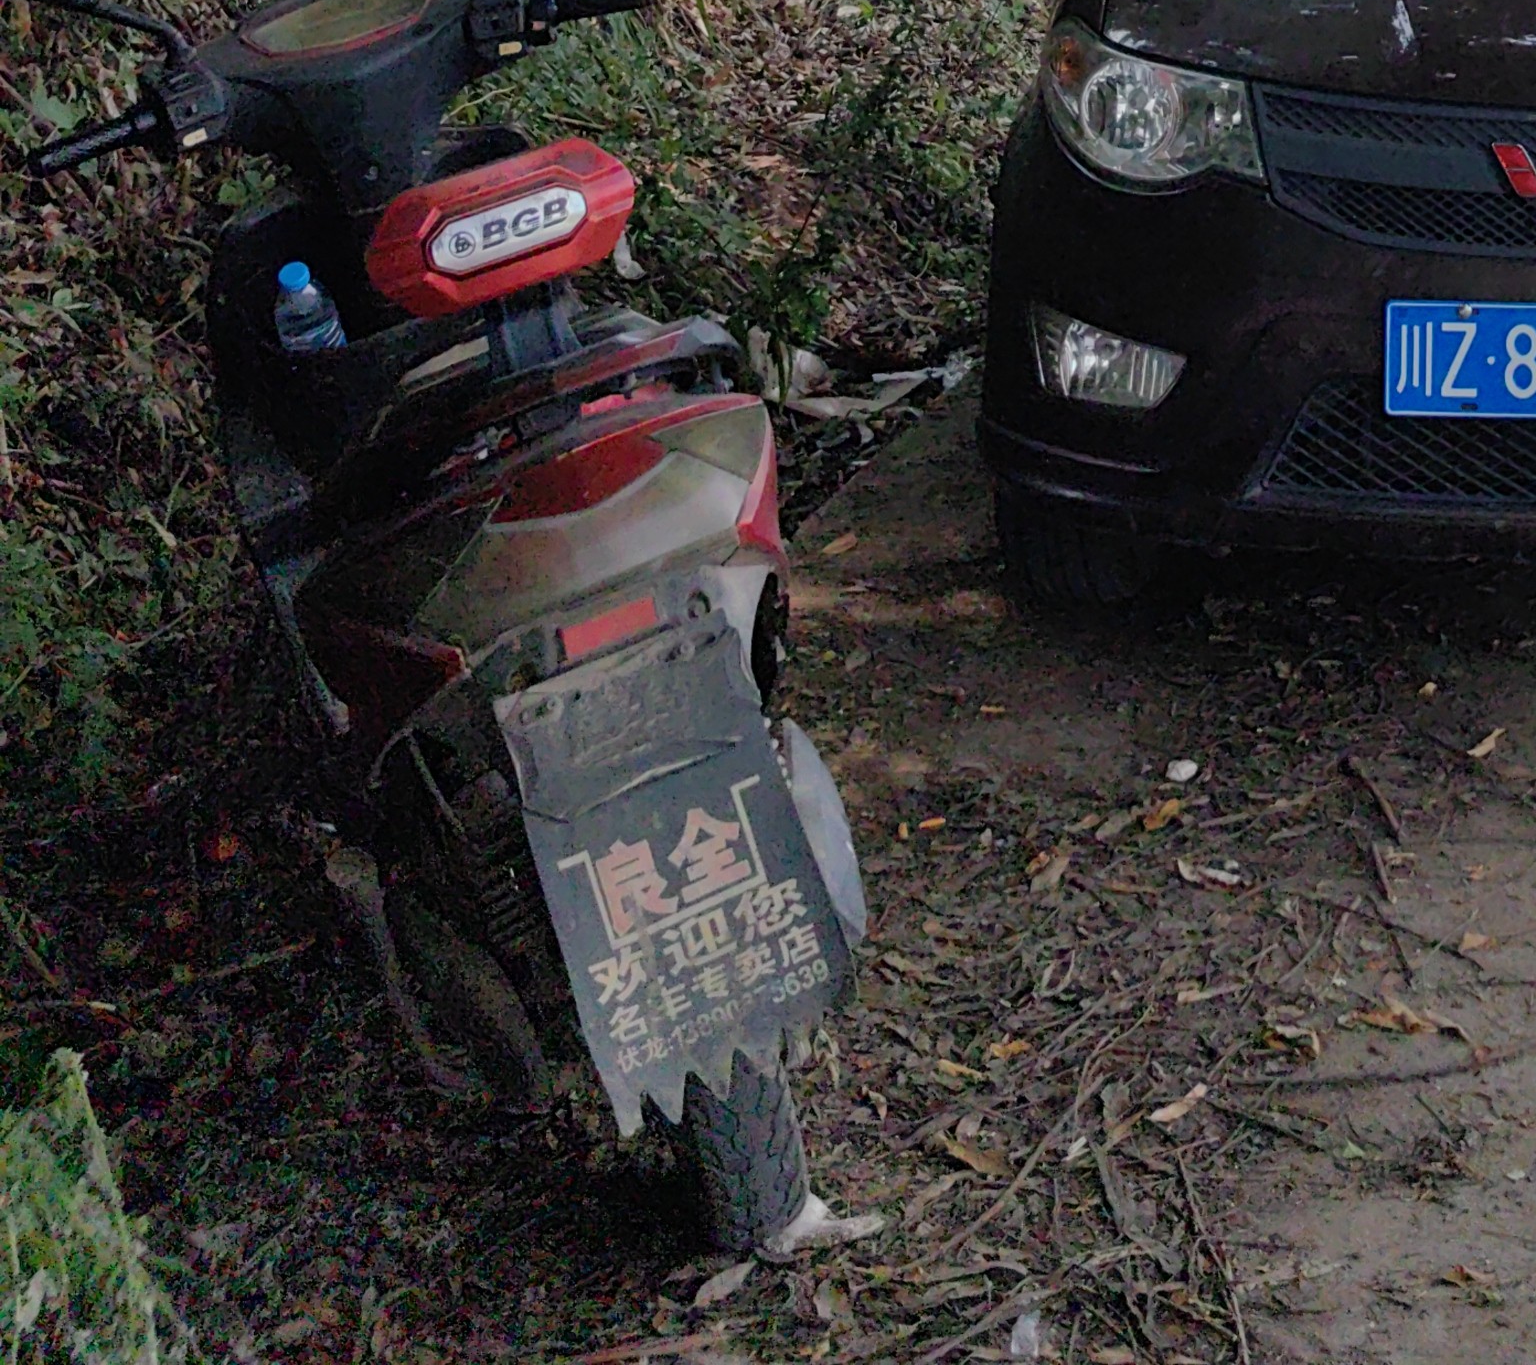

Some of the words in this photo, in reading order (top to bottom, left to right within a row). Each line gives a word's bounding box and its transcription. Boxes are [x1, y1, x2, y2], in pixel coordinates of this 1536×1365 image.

[481, 197, 569, 250] BGB
[595, 807, 752, 932] 良全
[588, 877, 808, 1005] 欢迎您
